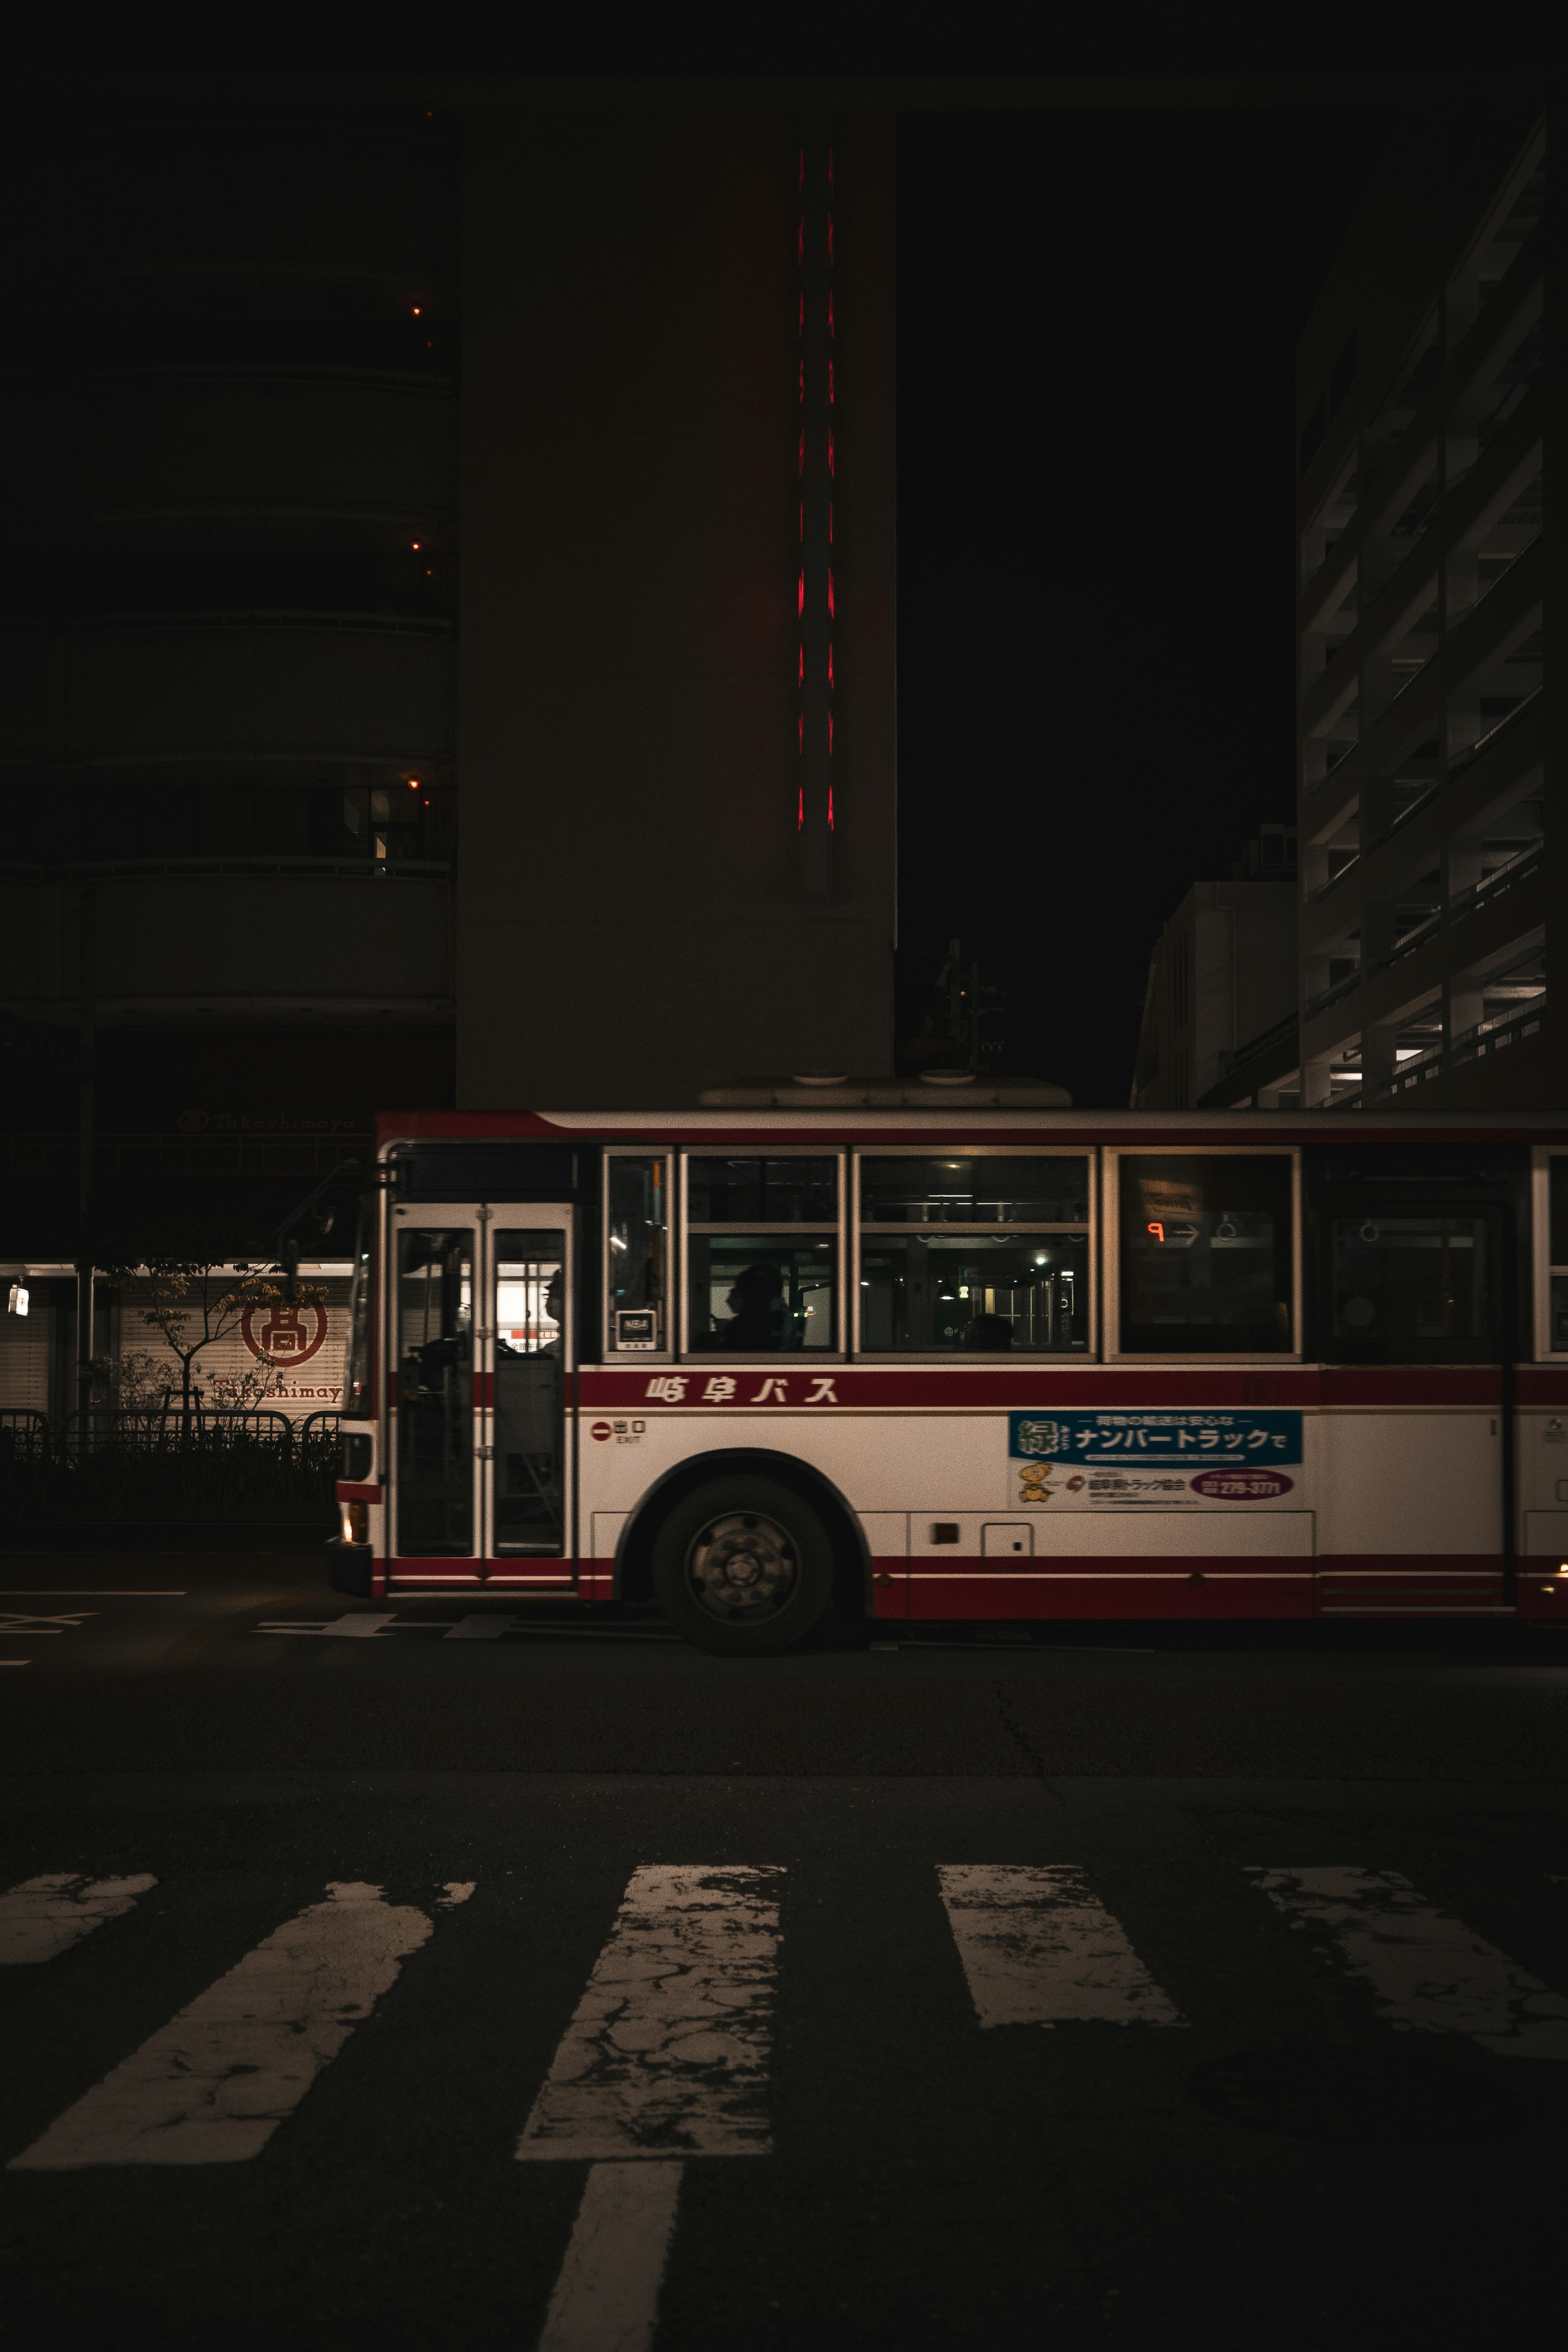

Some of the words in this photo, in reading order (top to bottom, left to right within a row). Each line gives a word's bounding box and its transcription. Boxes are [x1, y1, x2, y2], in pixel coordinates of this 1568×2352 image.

[214, 1114, 355, 1132] Takashimaya
[213, 1380, 343, 1403] Takashimay
[644, 1376, 839, 1403] 岐阜バス
[613, 1420, 646, 1434] 出口
